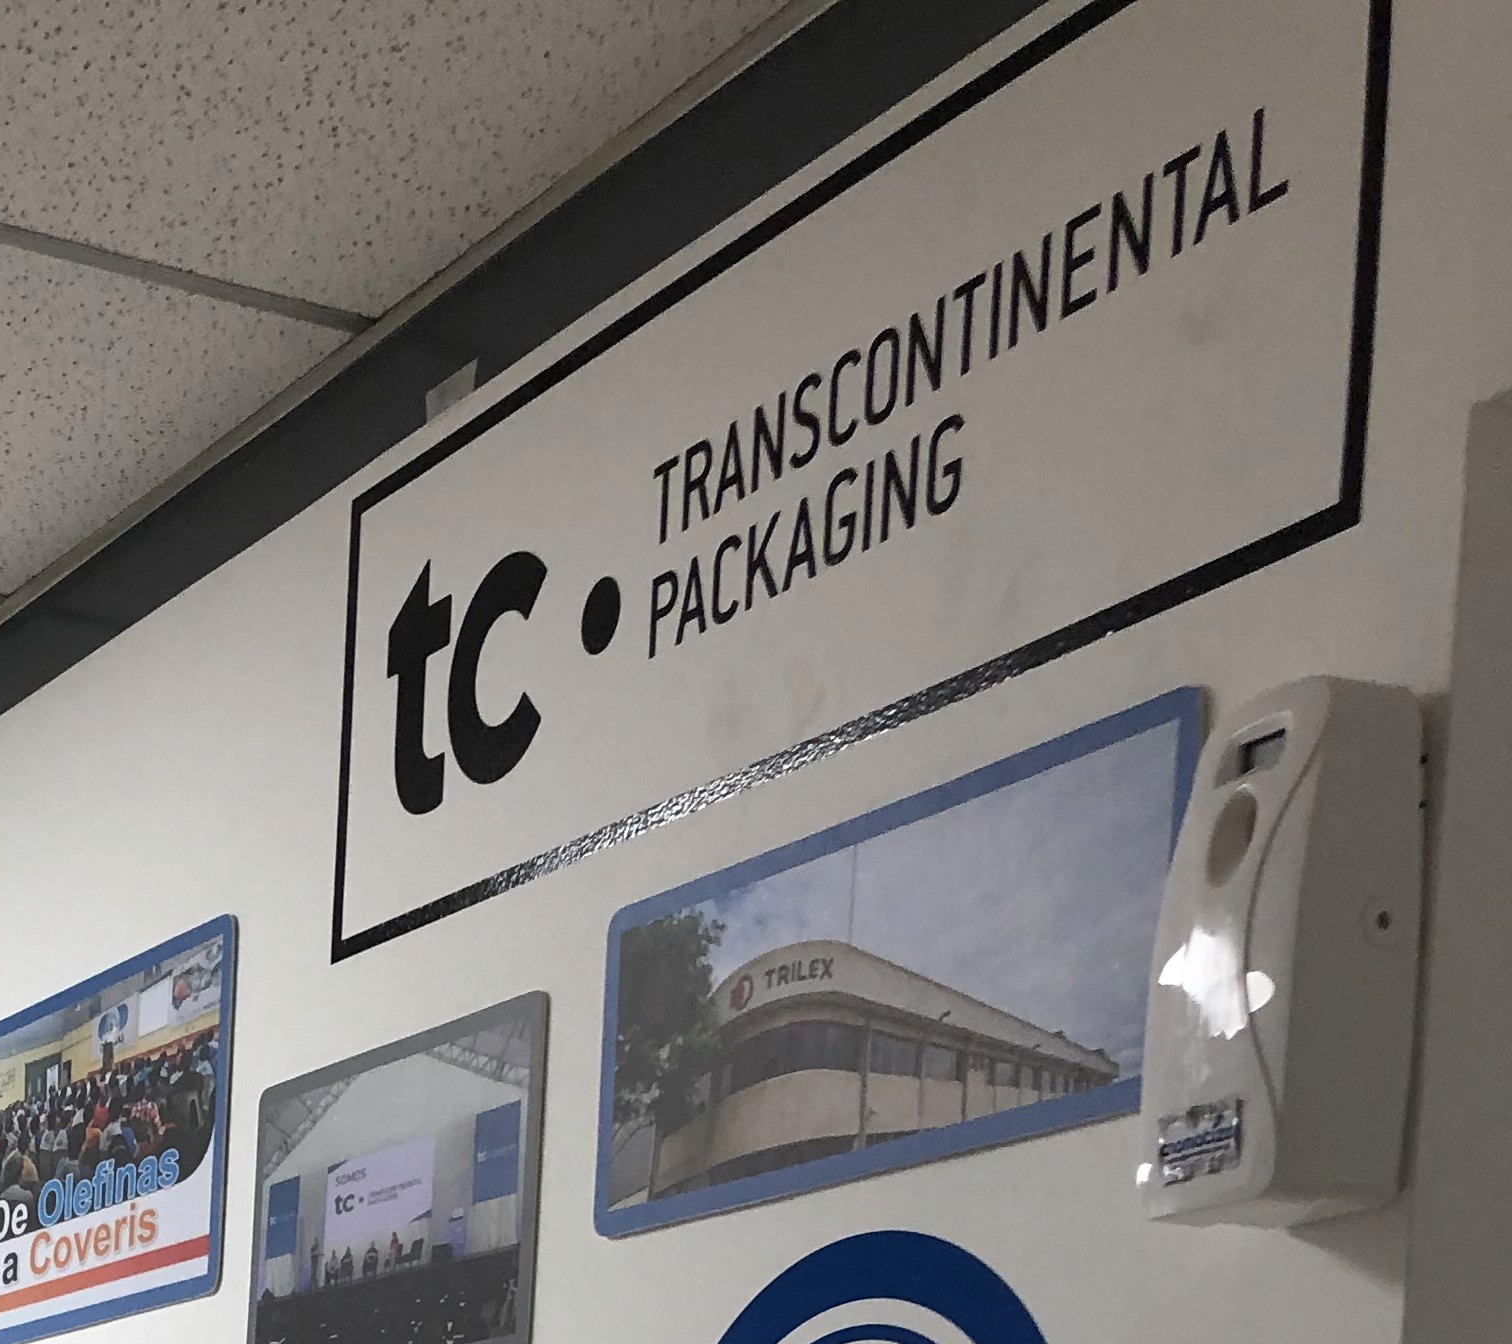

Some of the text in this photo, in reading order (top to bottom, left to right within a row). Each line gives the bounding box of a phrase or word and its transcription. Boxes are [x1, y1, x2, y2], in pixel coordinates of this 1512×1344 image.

[653, 107, 1288, 546] TRANSCONTINENTAL
[648, 413, 965, 660] PACKAGING
[387, 550, 548, 816] tc
[763, 957, 835, 990] TRILEX
[2, 1202, 157, 1285] a Coveris
[38, 1148, 179, 1227] Olefinas
